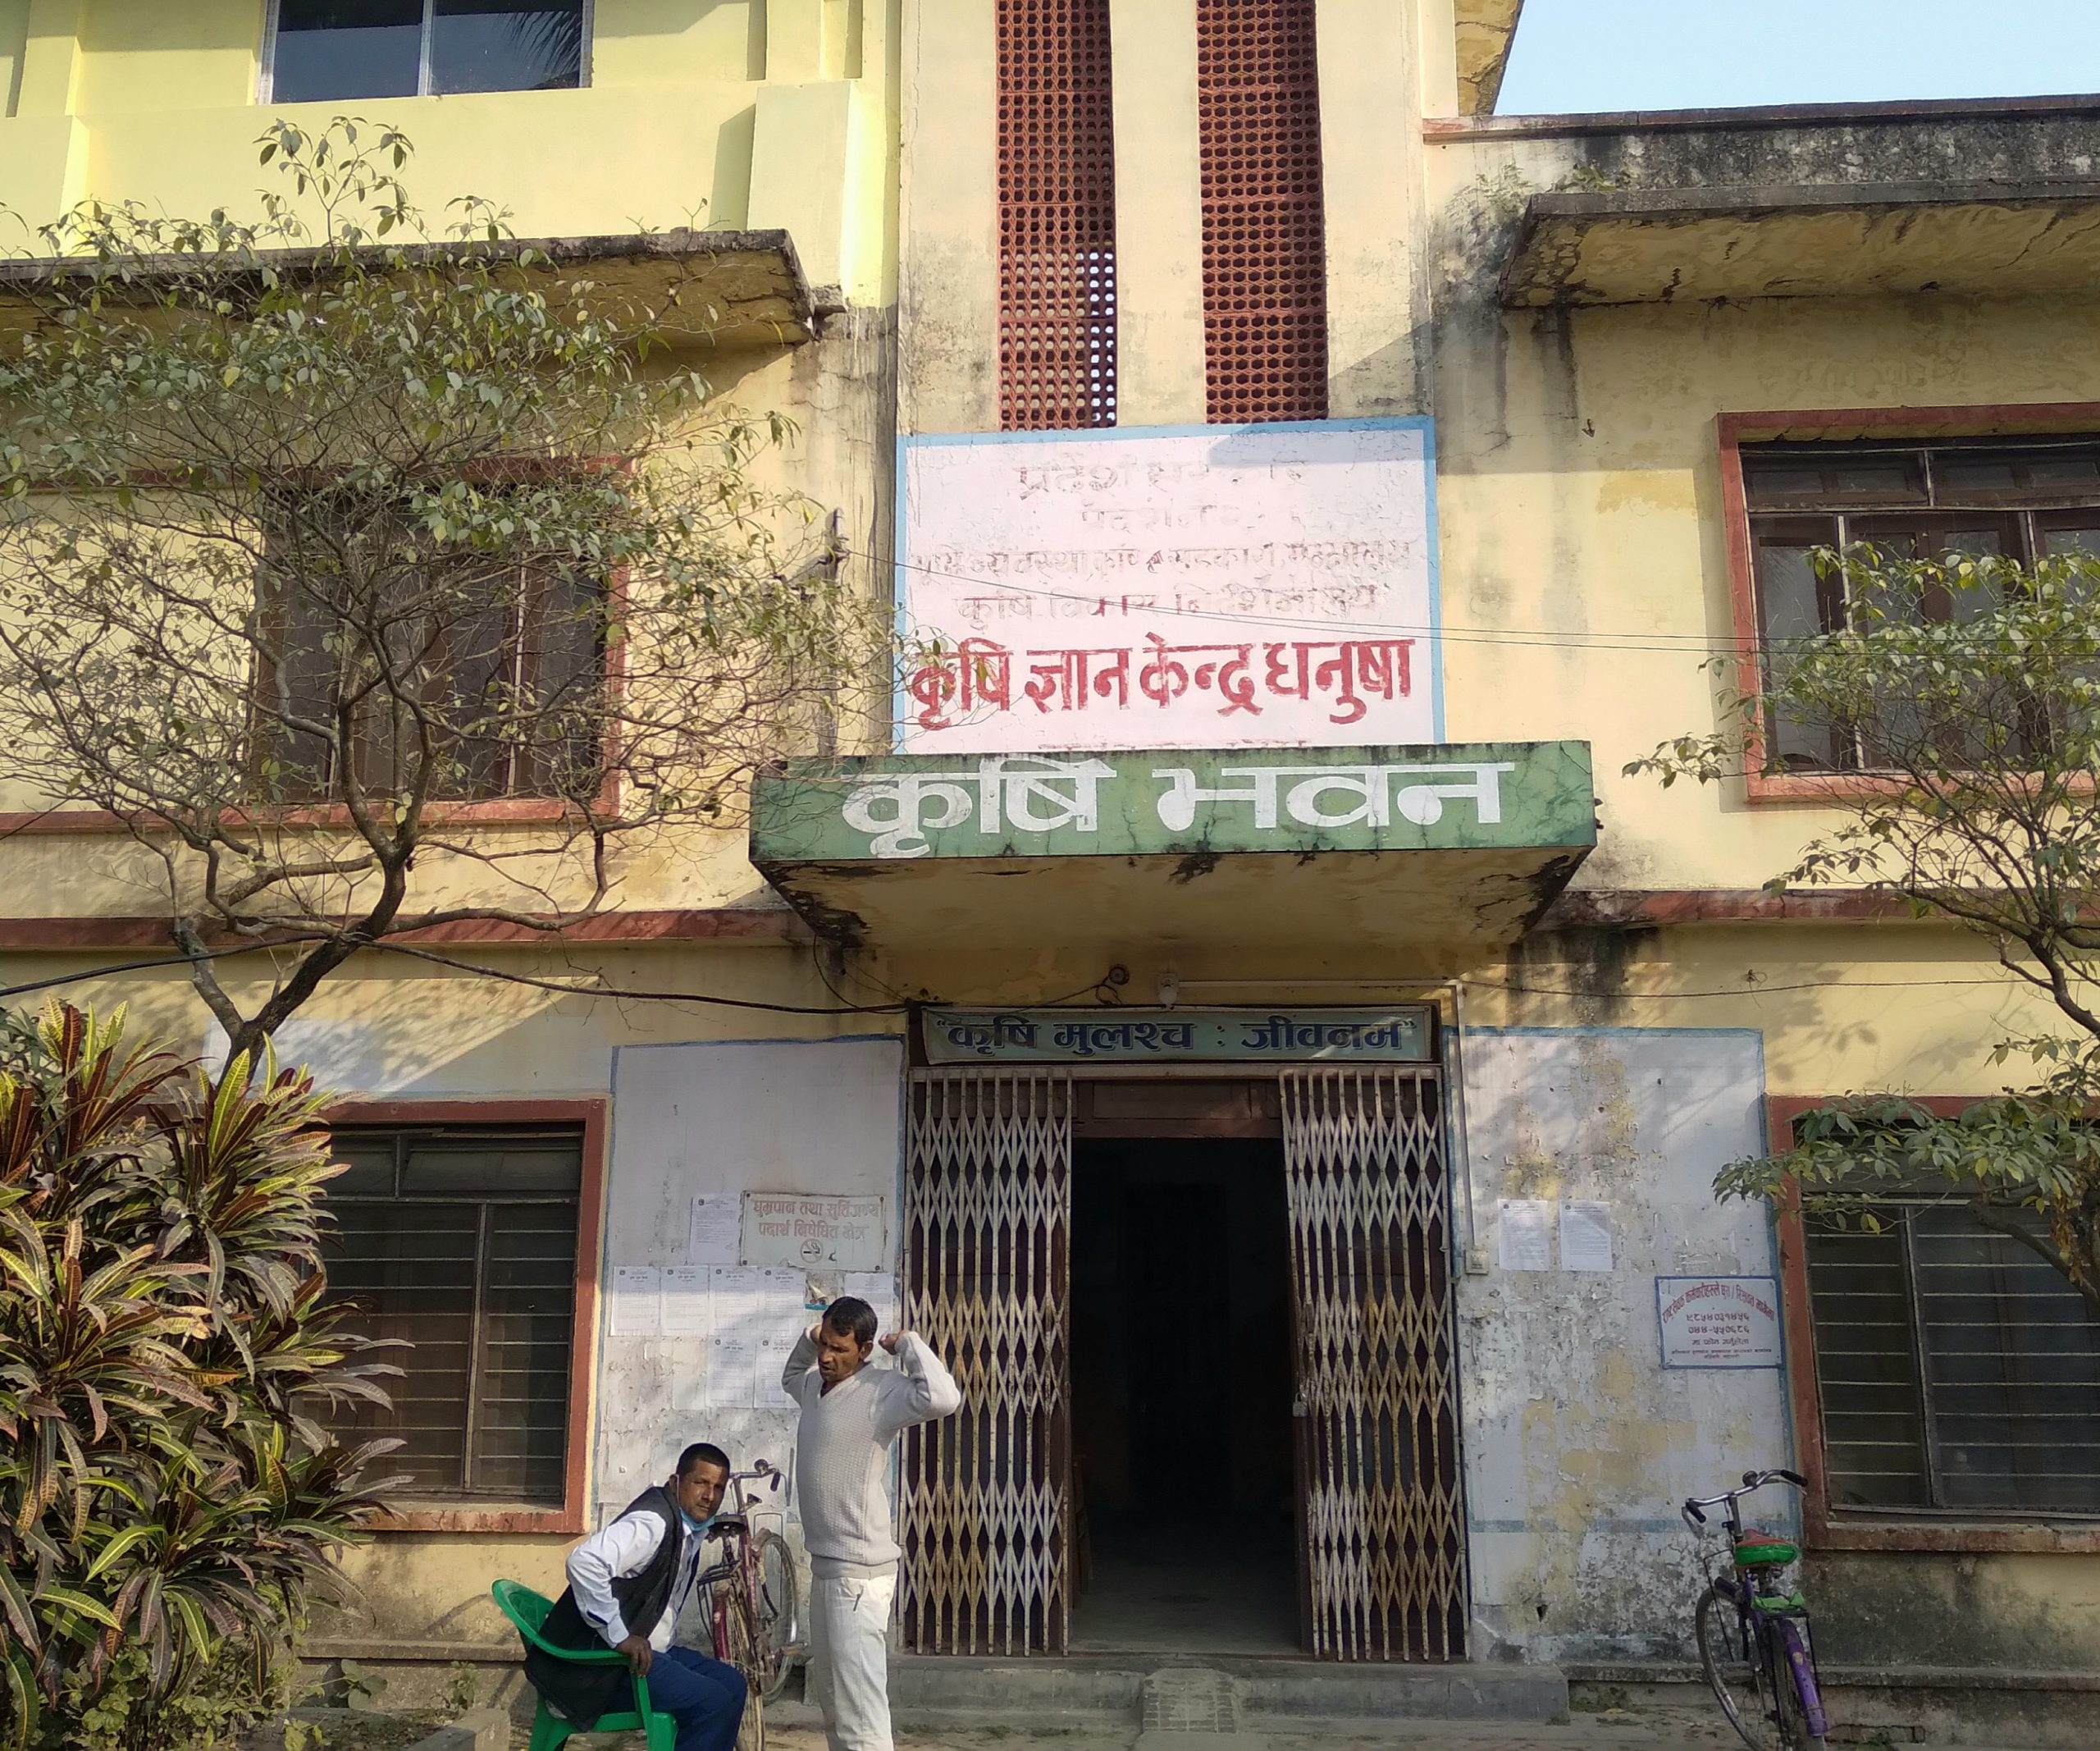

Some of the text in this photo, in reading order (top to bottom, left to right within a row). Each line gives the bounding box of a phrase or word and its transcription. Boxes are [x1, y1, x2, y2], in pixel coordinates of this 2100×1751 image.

[911, 631, 1416, 731] कृषि ज्ञान केन्द्र धनुषा
[840, 757, 1515, 858] कृषि भवन
[800, 1201, 824, 1216] तथा
